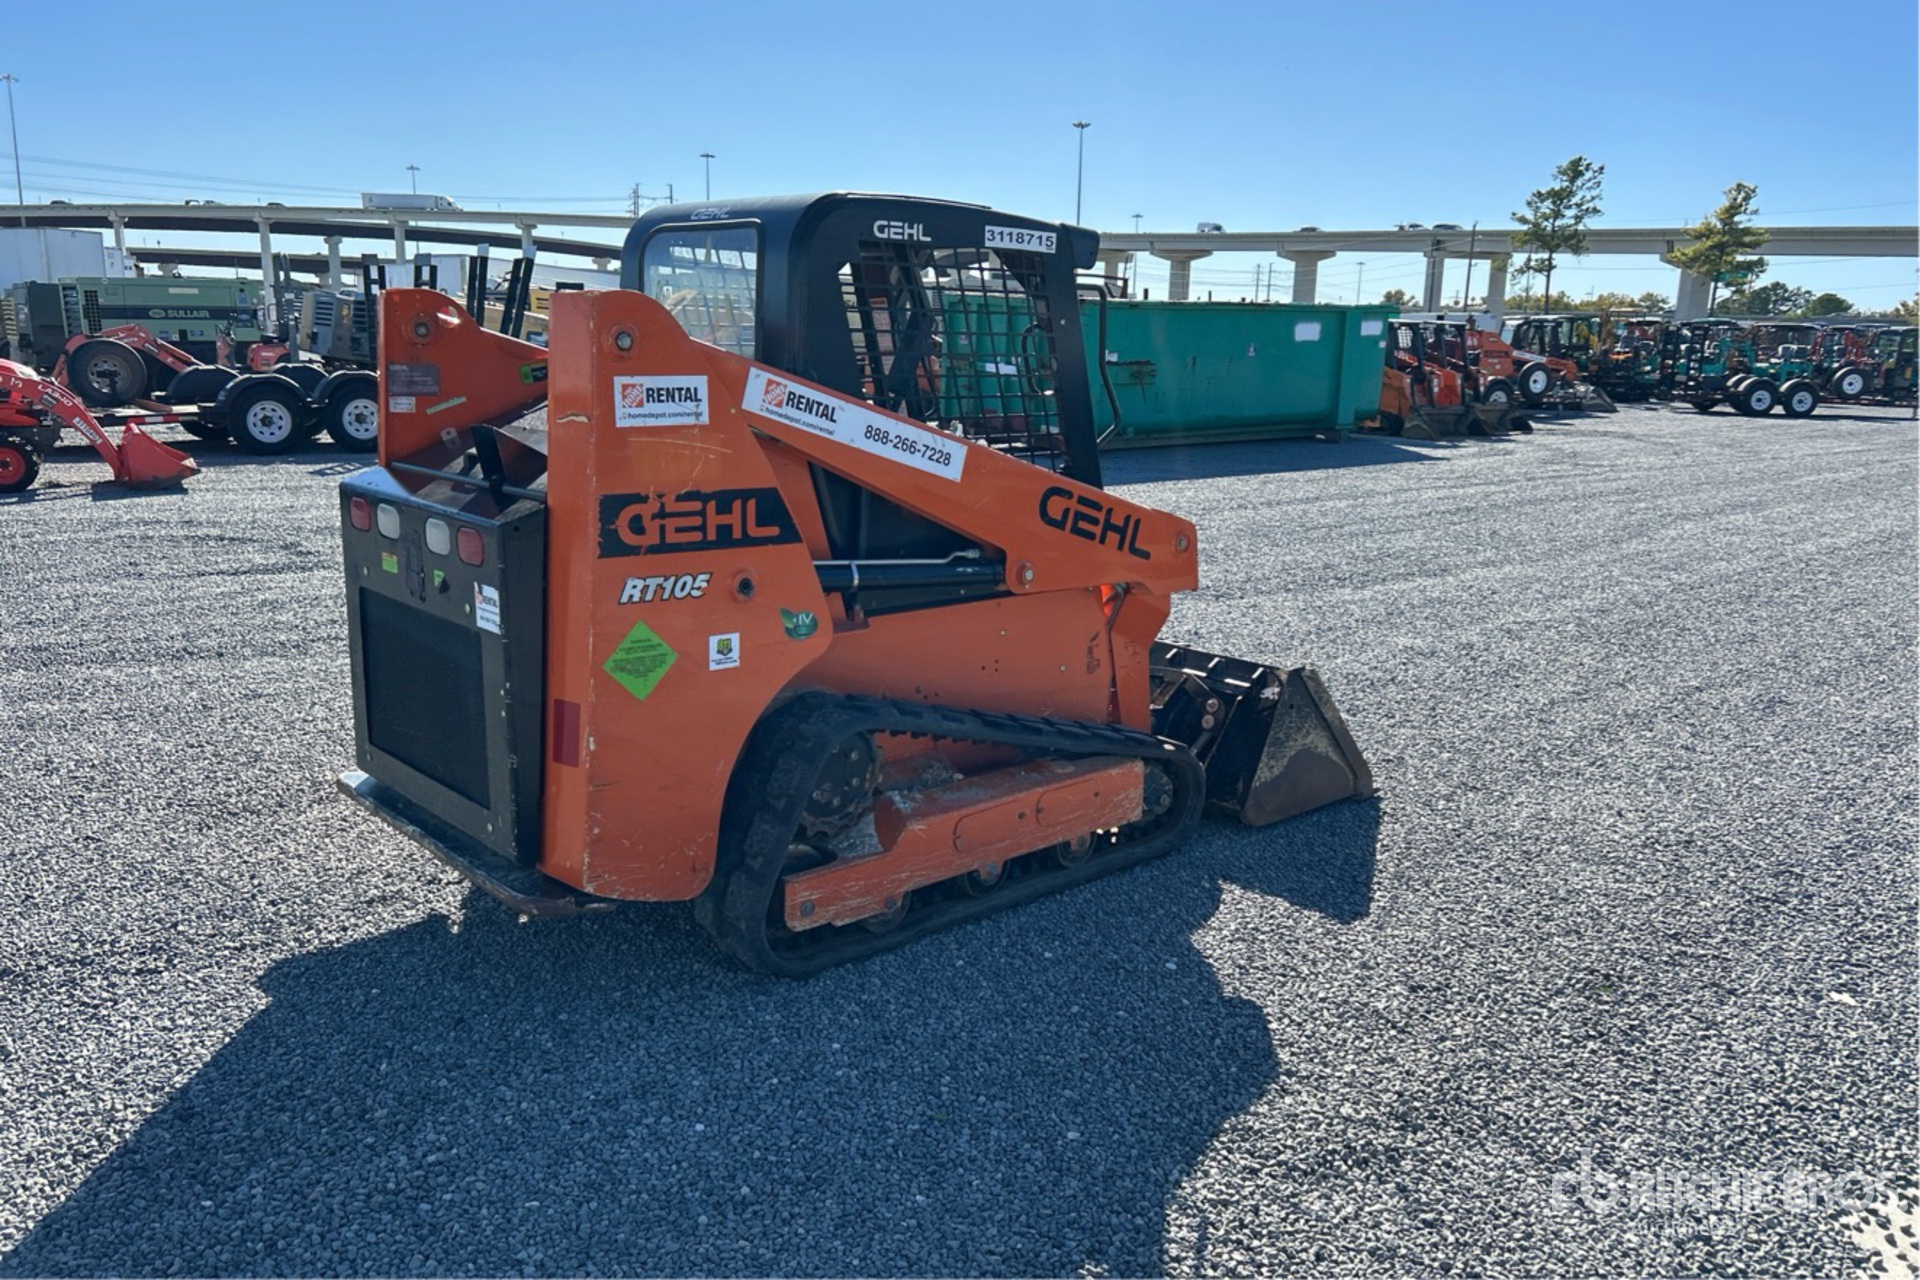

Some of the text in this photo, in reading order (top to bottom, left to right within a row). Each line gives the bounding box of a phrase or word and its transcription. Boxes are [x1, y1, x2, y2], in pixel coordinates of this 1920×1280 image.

[690, 206, 730, 220] GEHL
[873, 219, 932, 242] GEHL
[986, 229, 1055, 248] 3118715
[167, 309, 210, 318] SULLAIR
[645, 387, 702, 404] RENTAL
[785, 390, 837, 424] RENTAL
[628, 410, 703, 420] homedepot.com/rental
[765, 406, 835, 437] homedepot.com/rental
[864, 424, 952, 467] 888-266-7228
[616, 498, 780, 546] GEHL
[1038, 485, 1152, 561] GEHL
[618, 572, 713, 606] RT105
